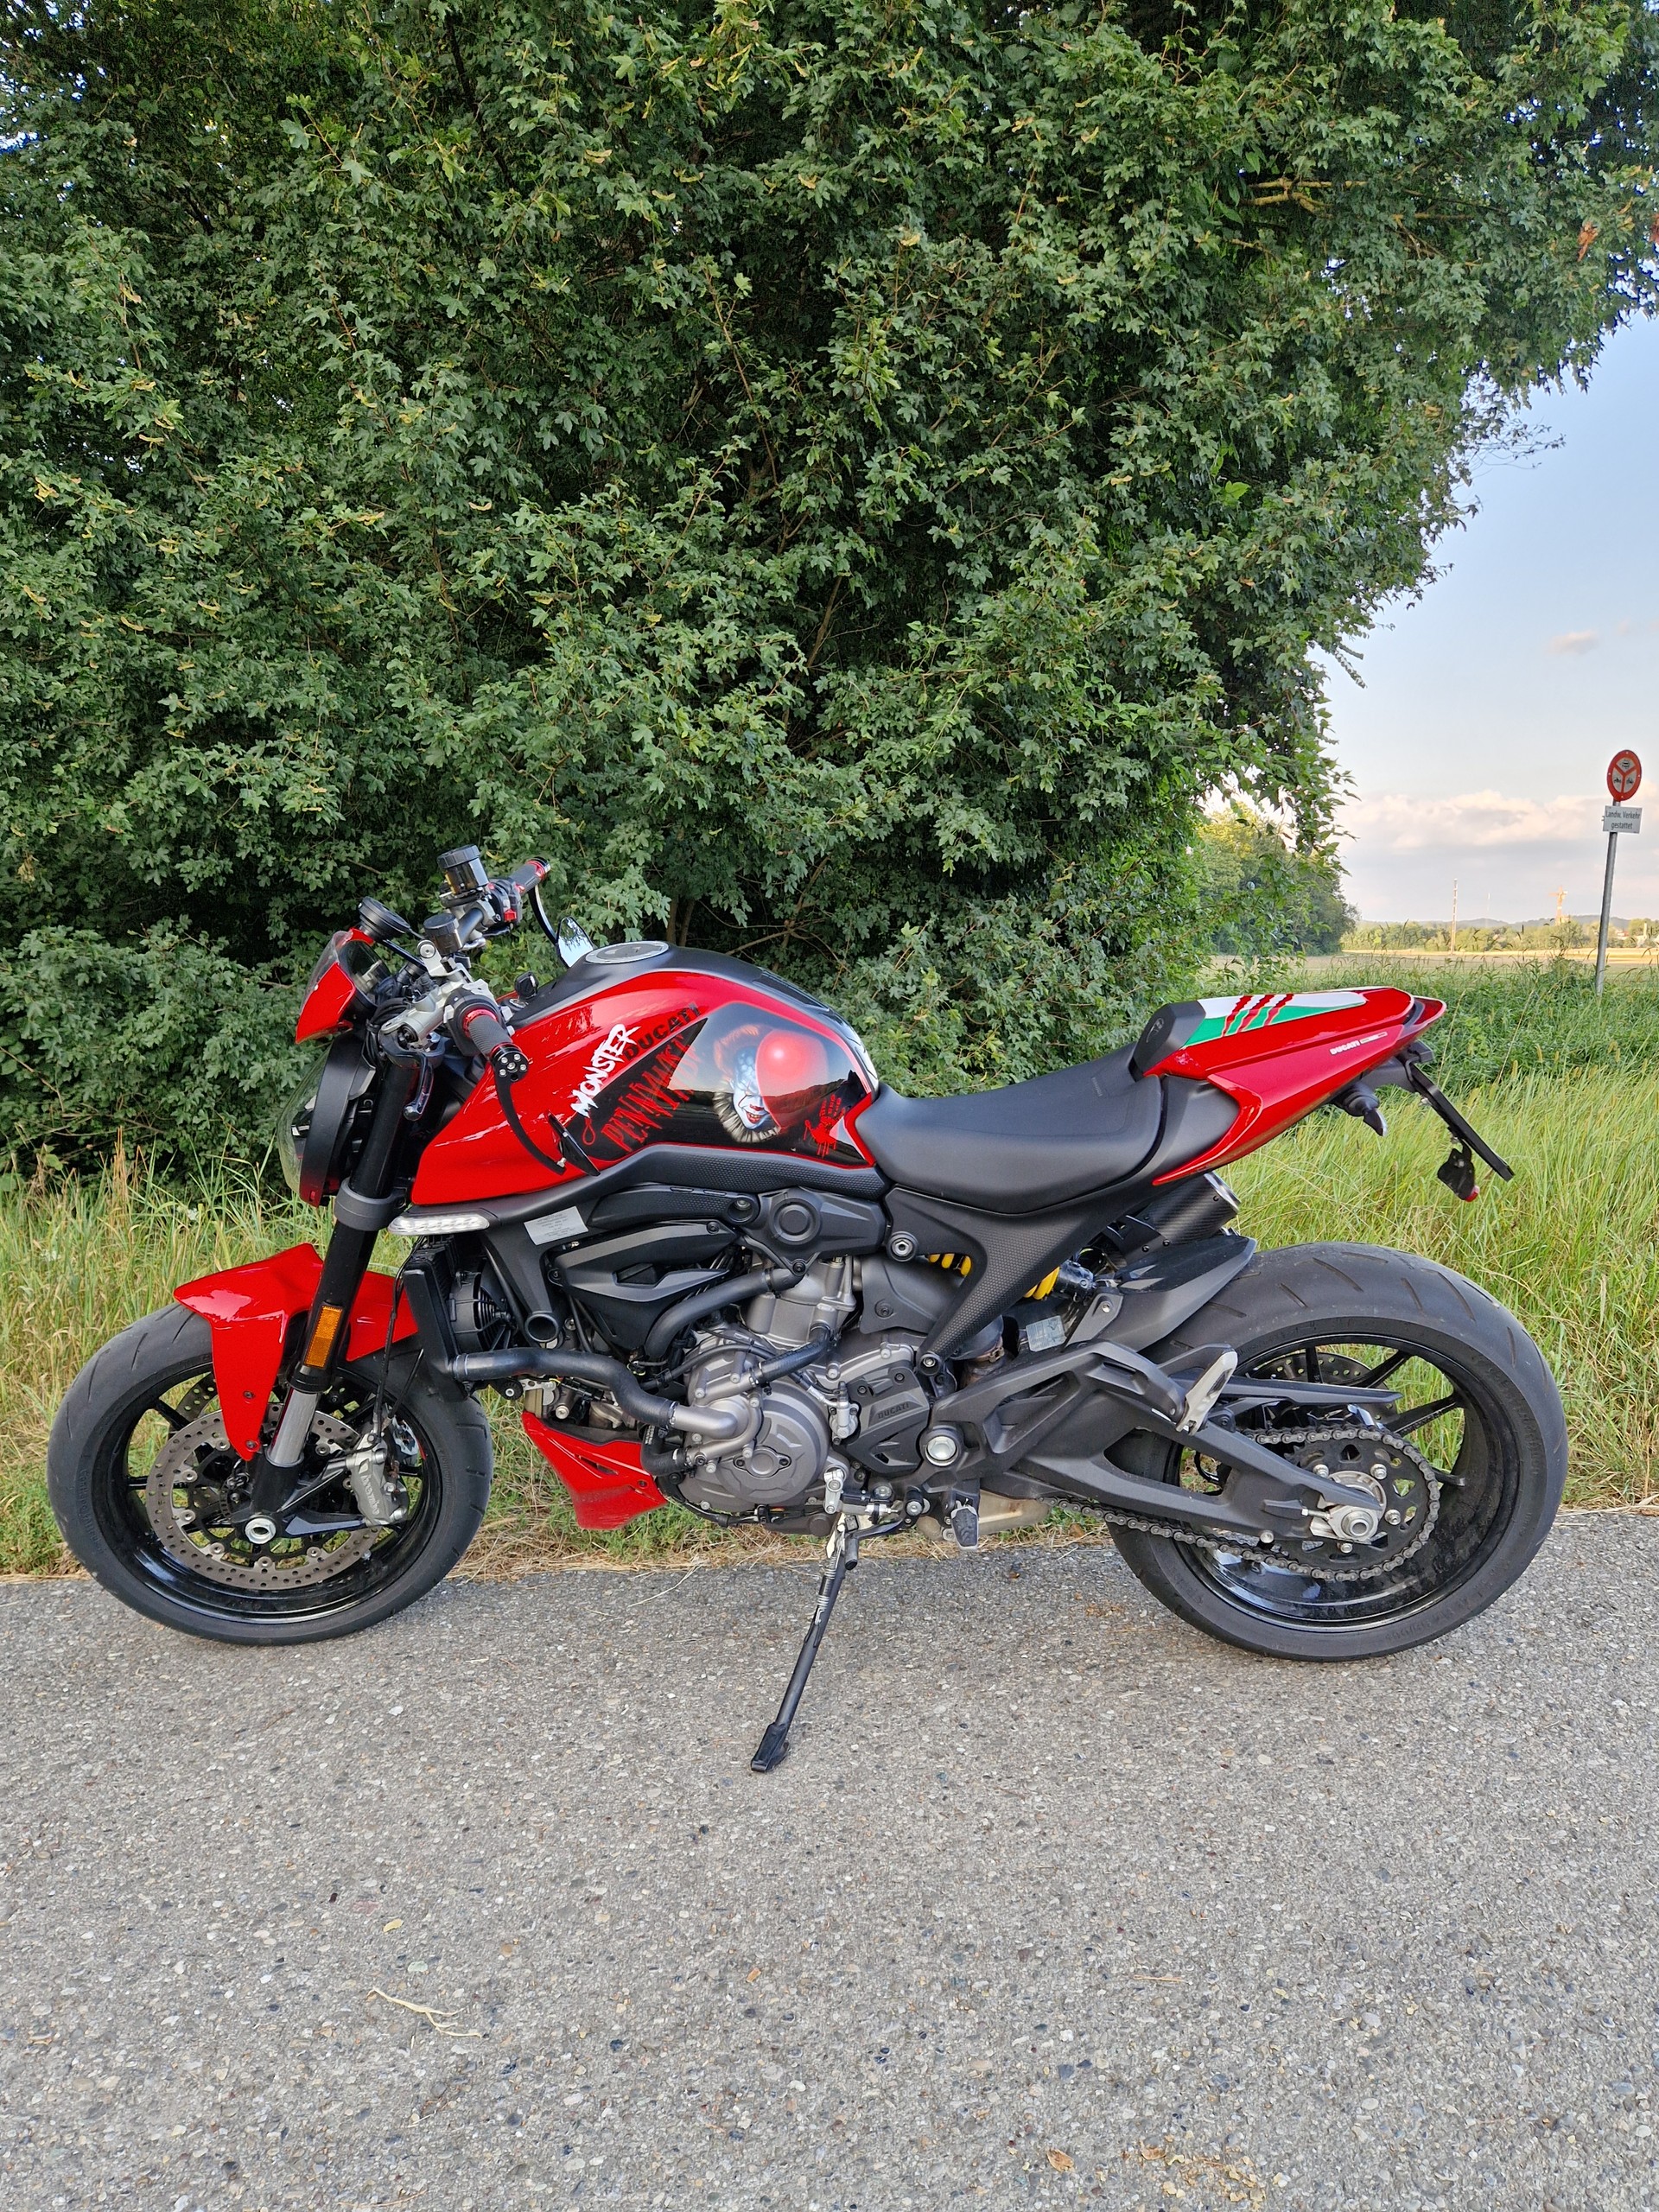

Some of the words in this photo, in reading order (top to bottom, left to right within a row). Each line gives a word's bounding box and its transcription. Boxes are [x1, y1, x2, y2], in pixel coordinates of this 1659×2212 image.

[623, 1003, 701, 1061] DUCATI
[1330, 1040, 1360, 1054] DUCATI
[570, 1024, 641, 1117] MONSTER
[877, 1402, 909, 1418] DUCATI
[360, 1475, 379, 1515] brembo
